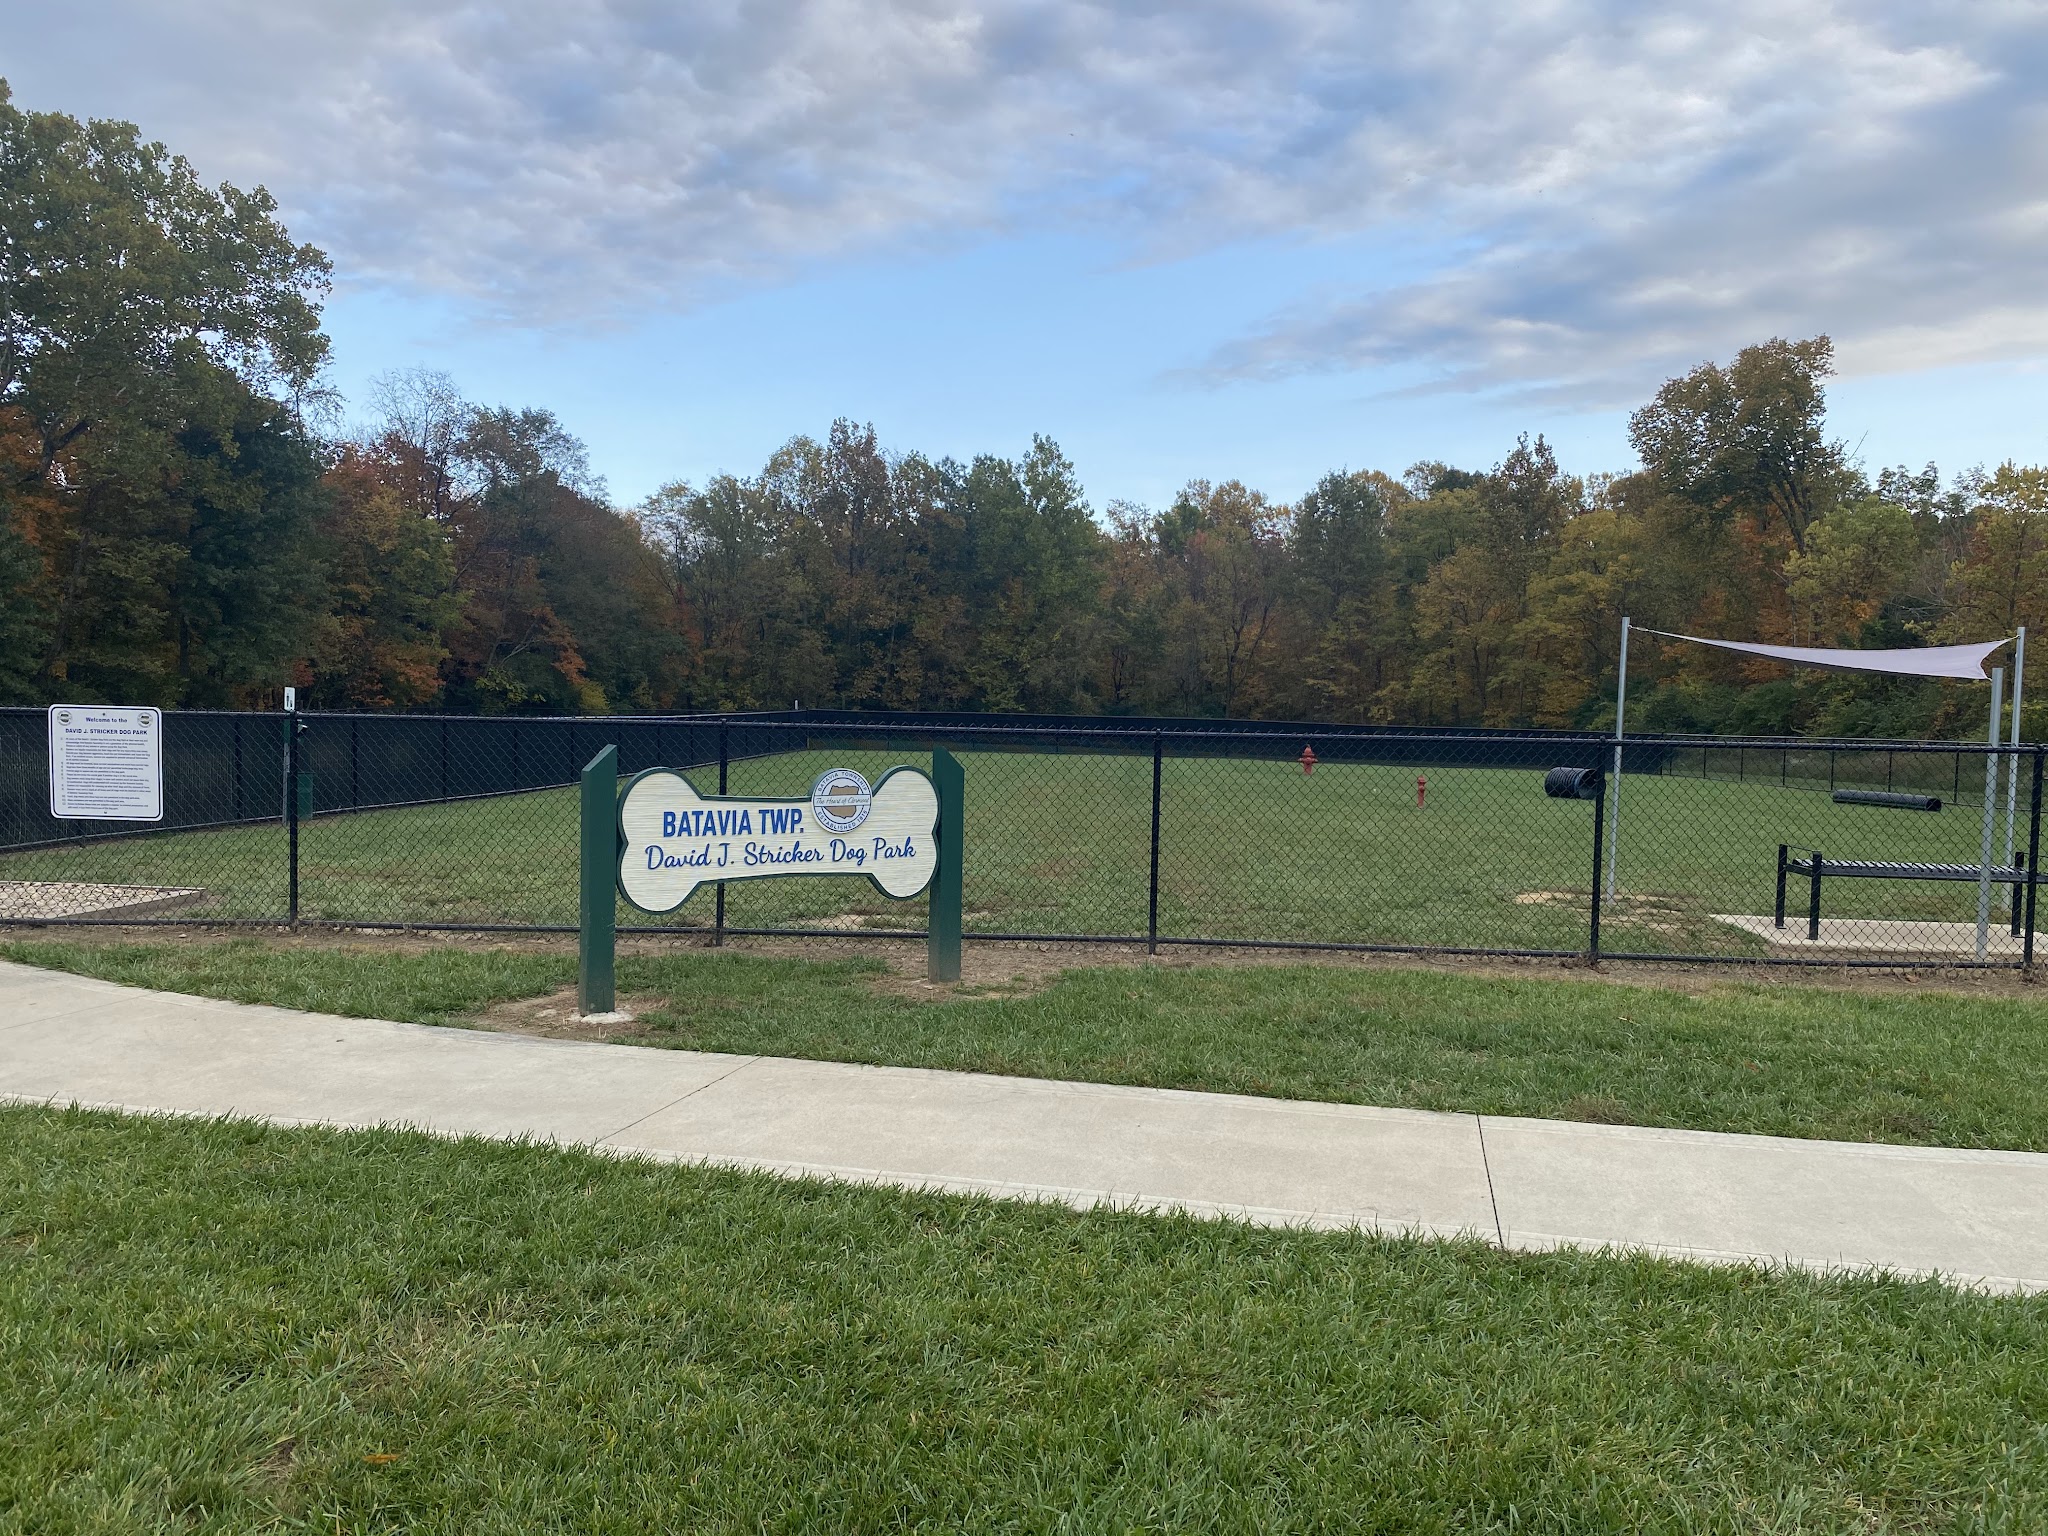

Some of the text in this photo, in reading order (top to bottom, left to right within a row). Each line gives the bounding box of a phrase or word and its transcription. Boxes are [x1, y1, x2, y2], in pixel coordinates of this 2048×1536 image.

[818, 772, 867, 791] BATAVIA TOWNSHIP
[663, 808, 805, 838] BATAVIA TWP.
[818, 812, 856, 830] ESTABLISHED
[645, 836, 916, 870] David J. Stricker Dog Park
